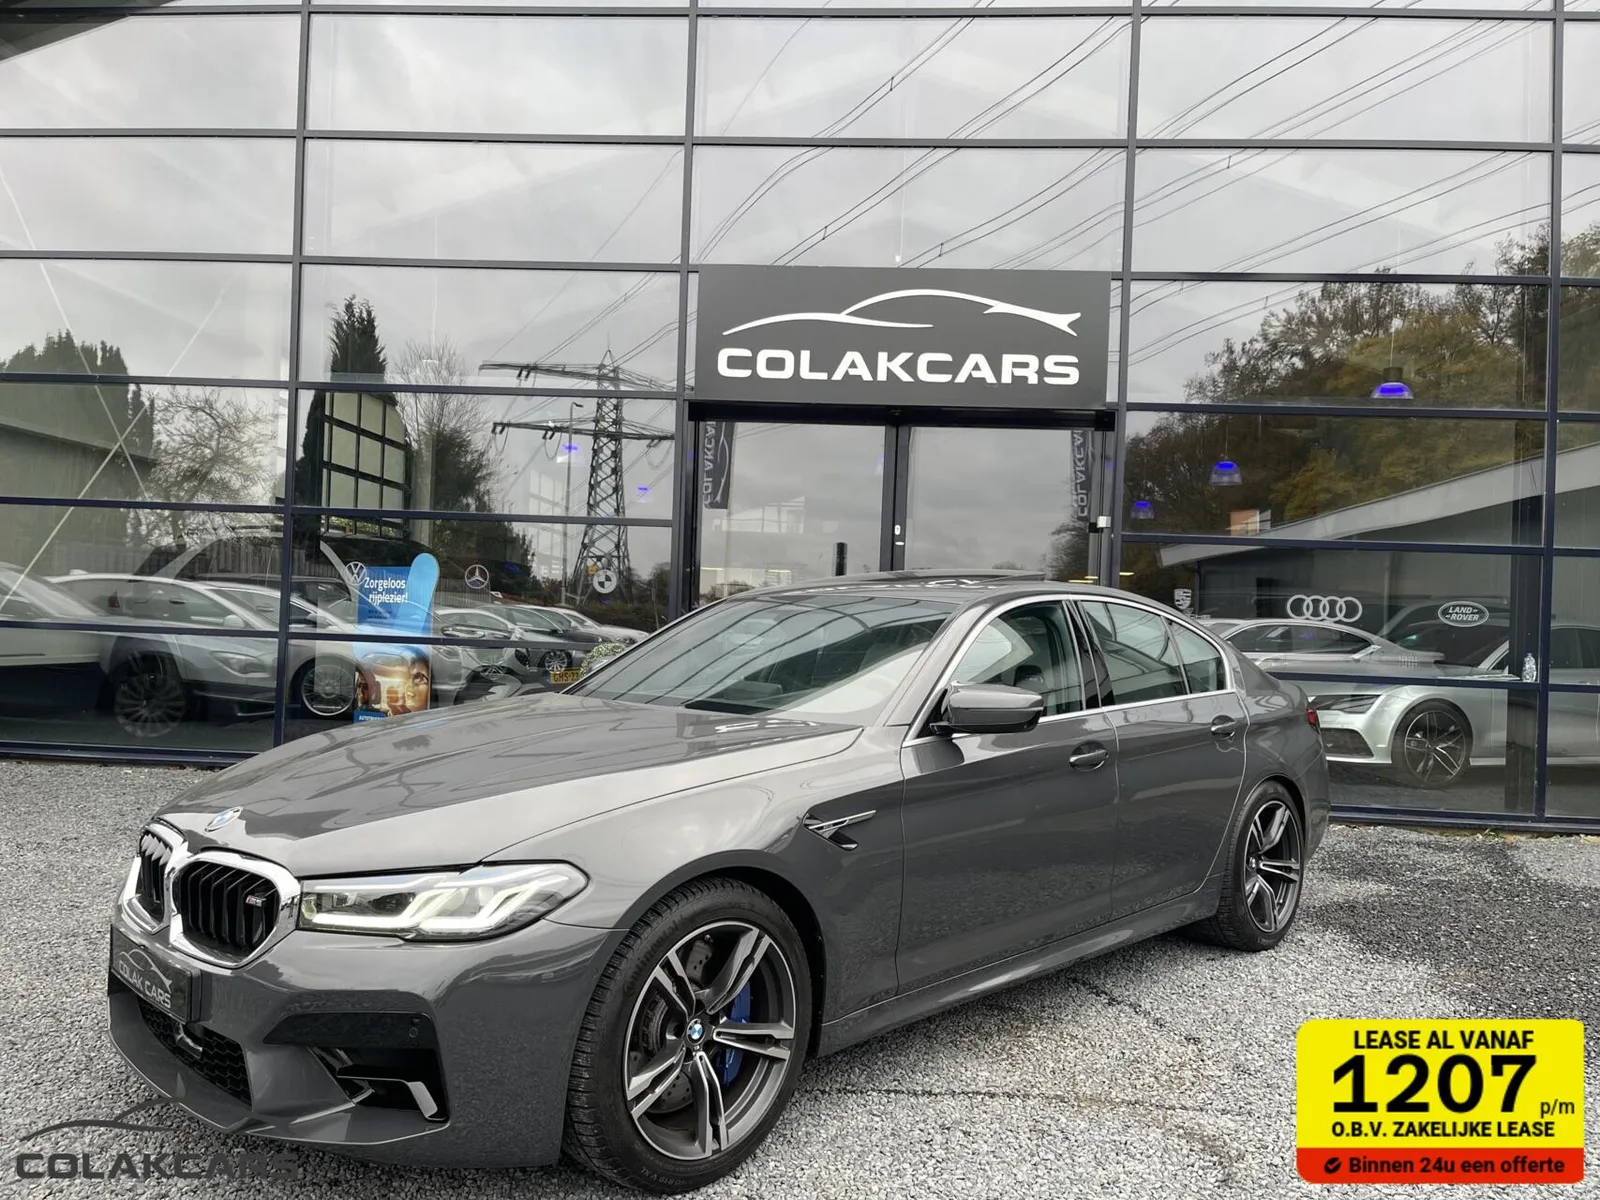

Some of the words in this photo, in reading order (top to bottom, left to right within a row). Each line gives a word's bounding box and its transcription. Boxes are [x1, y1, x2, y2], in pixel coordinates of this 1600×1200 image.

[717, 348, 1080, 385] COLAKCARS
[364, 577, 406, 591] Zorgeloos
[369, 592, 408, 606] rijplezier!
[1450, 613, 1479, 621] ROVER
[144, 980, 171, 1009] CARS
